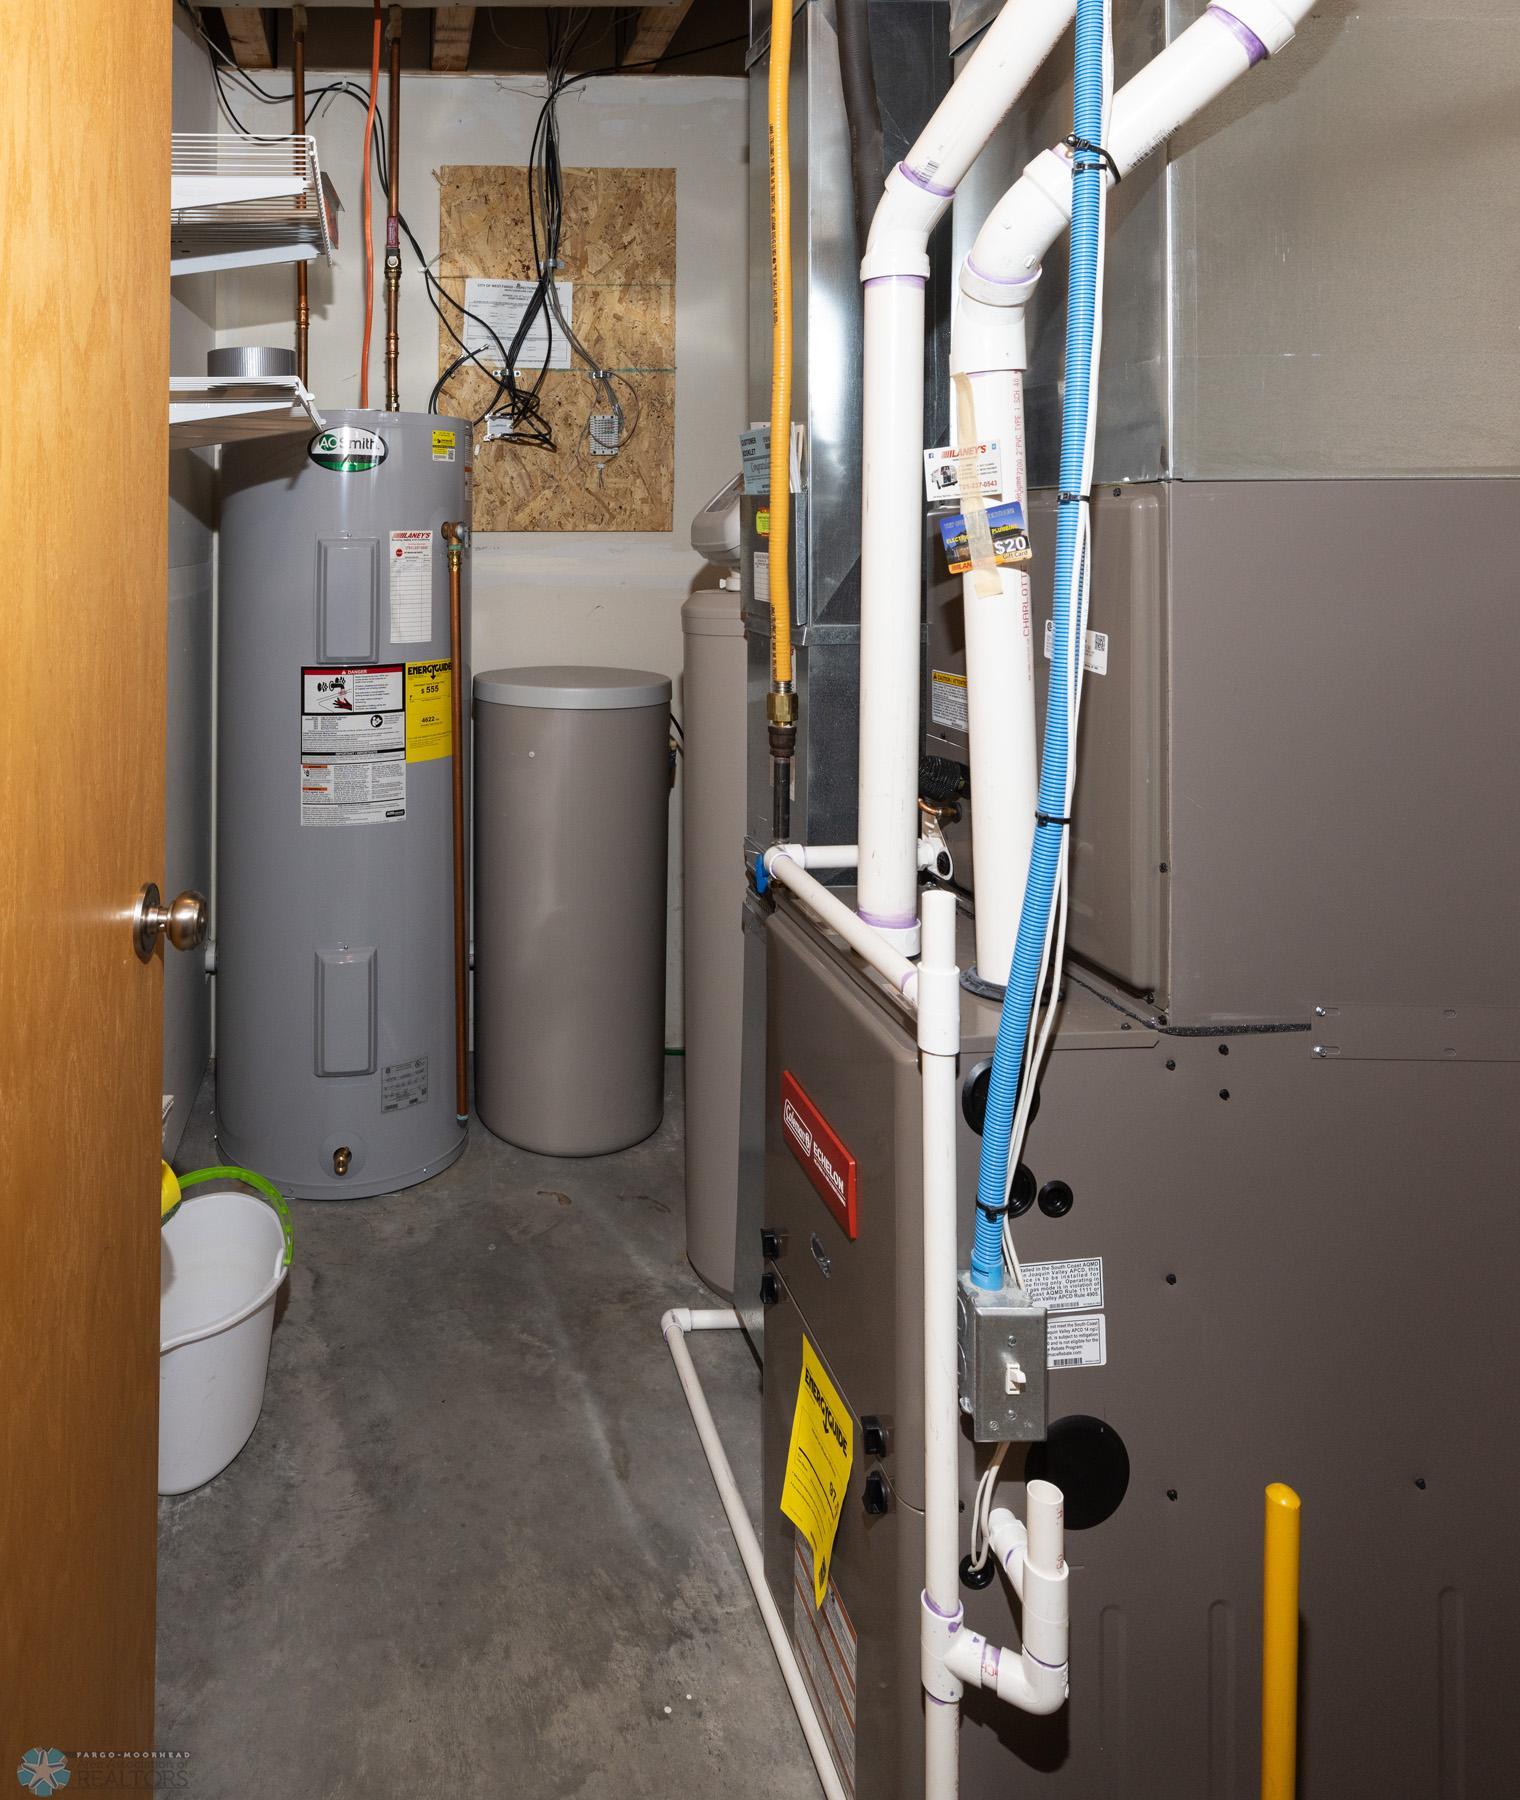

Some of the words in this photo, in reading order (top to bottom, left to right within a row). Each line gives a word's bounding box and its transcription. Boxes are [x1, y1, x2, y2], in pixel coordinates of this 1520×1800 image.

[994, 536, 1027, 555] $20
[1015, 550, 1029, 558] Card
[426, 685, 439, 694] 555
[813, 1141, 845, 1194] ECHELON
